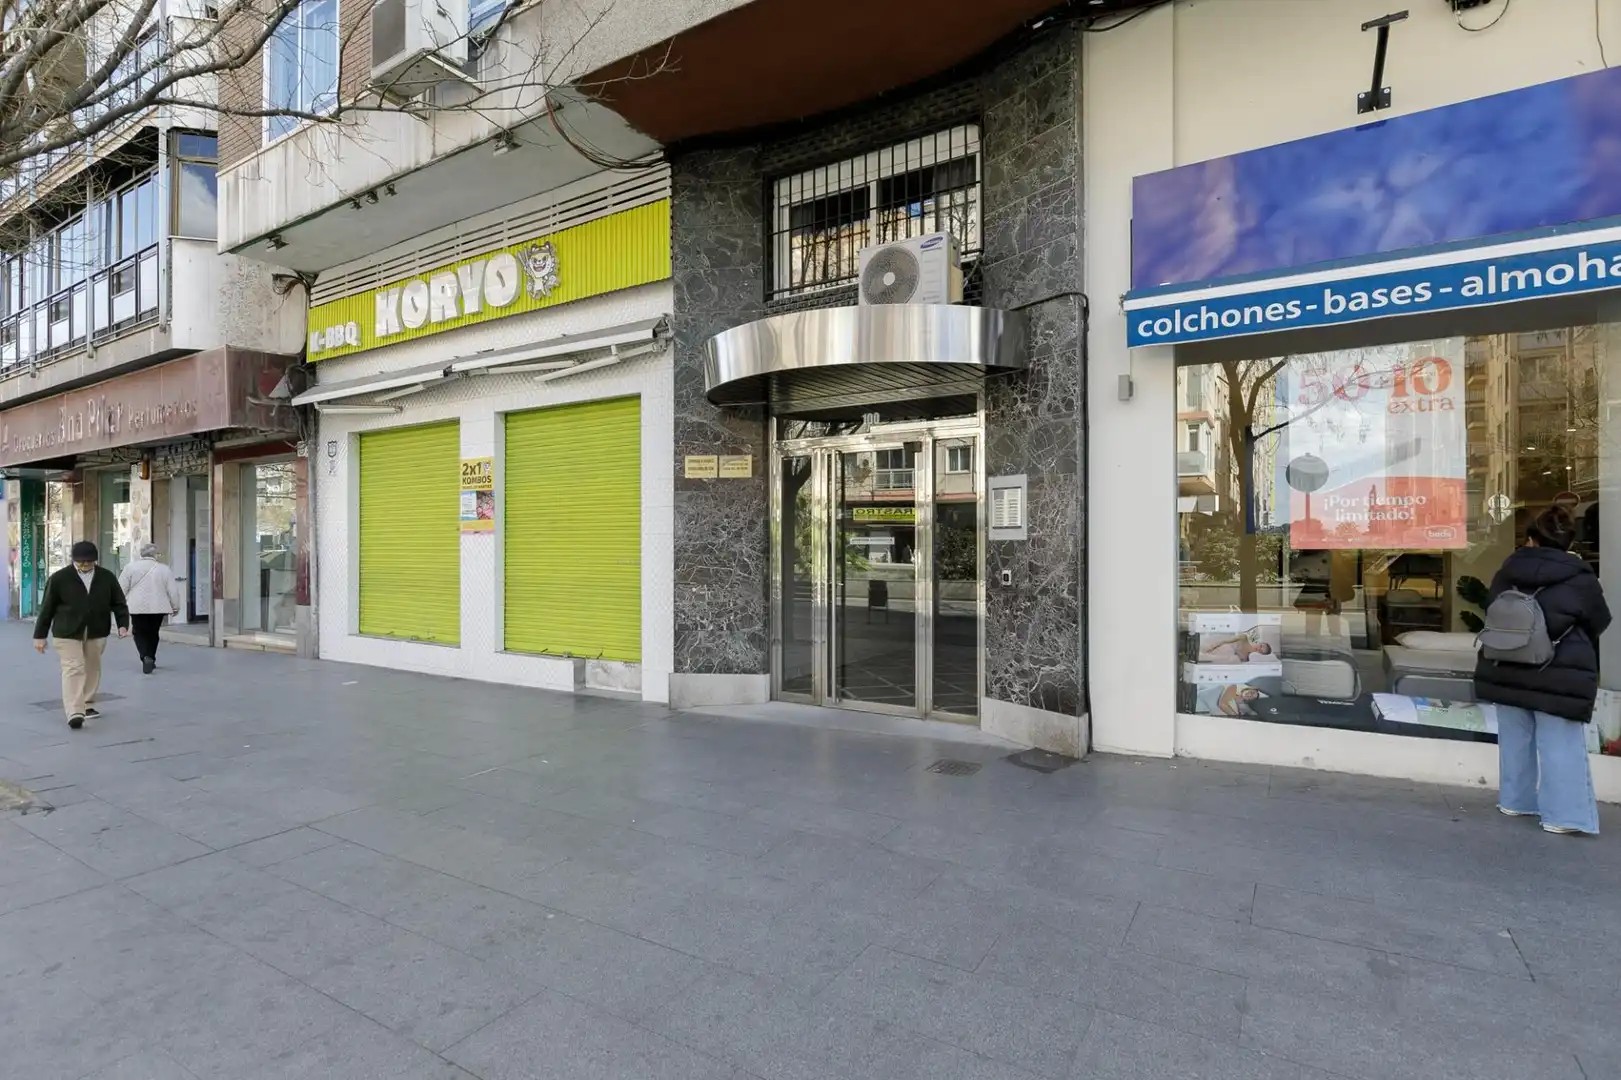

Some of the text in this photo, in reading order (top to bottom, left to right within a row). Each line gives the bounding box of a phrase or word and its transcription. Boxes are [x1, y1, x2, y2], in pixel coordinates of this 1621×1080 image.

[375, 253, 519, 338] KORYO
[1137, 299, 1301, 338] colchones
[1323, 281, 1432, 316] bases
[310, 321, 361, 353] K-BBQ
[1387, 395, 1455, 415] extra
[862, 412, 880, 425] 100
[462, 462, 481, 476] 2x1
[462, 475, 492, 485] KOMBOS
[1364, 493, 1427, 510] tiempo
[1335, 507, 1415, 522] limitado!
